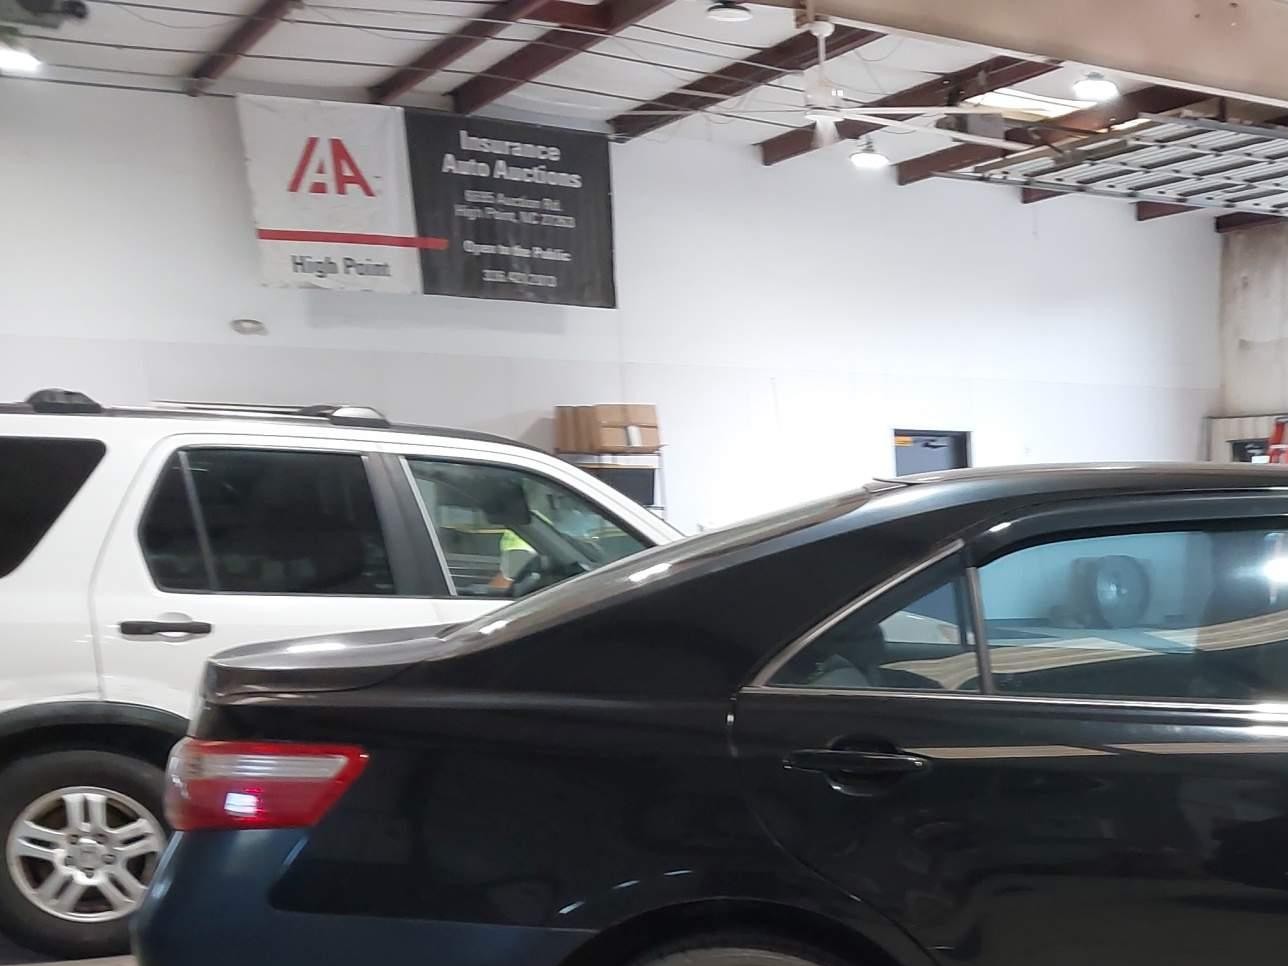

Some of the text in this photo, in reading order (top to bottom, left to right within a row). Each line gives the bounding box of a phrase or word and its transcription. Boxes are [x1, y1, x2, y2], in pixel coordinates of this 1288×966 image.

[459, 130, 560, 160] Insurance
[442, 153, 583, 188] Auto Auctions
[463, 240, 572, 261] Open to the Public
[291, 255, 391, 278] High Point
